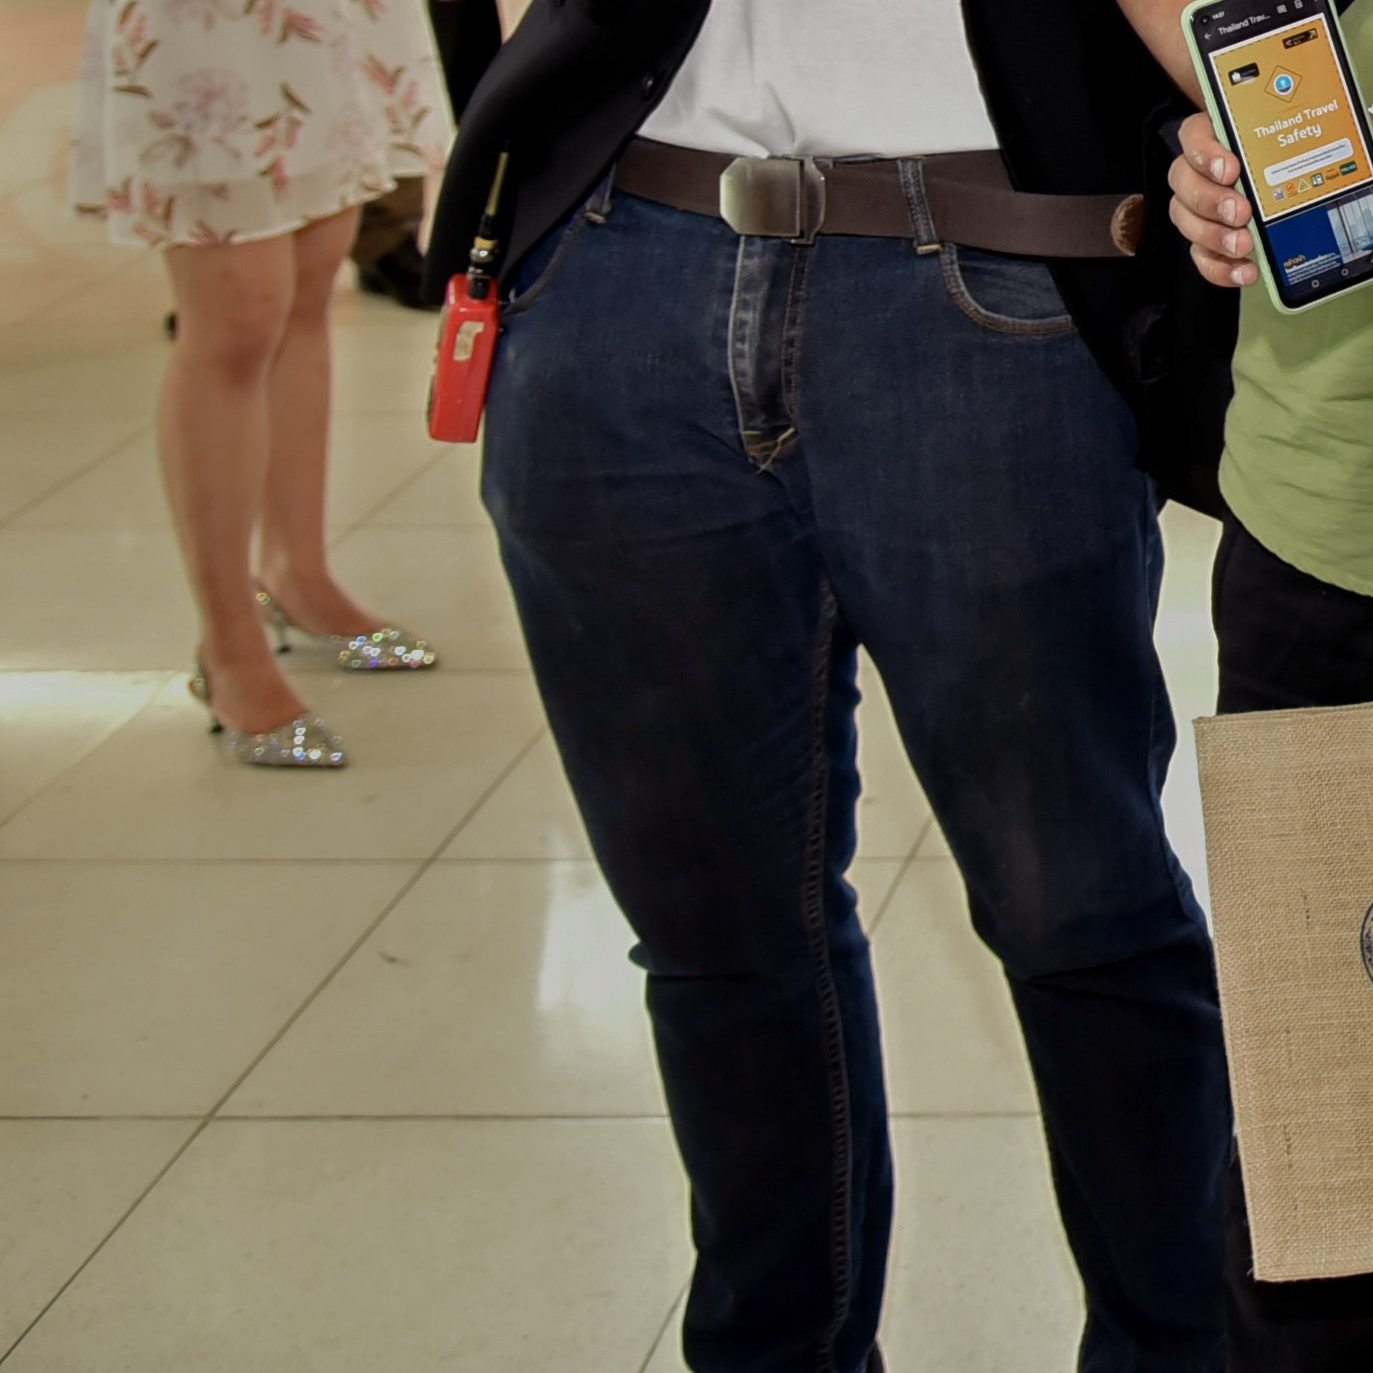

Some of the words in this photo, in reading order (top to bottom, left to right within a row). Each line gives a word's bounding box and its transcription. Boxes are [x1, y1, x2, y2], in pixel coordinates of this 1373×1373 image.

[1218, 18, 1249, 35] Thailand
[1253, 109, 1304, 139] Thailand
[1303, 99, 1340, 121] Travel
[1277, 123, 1322, 148] Safety
